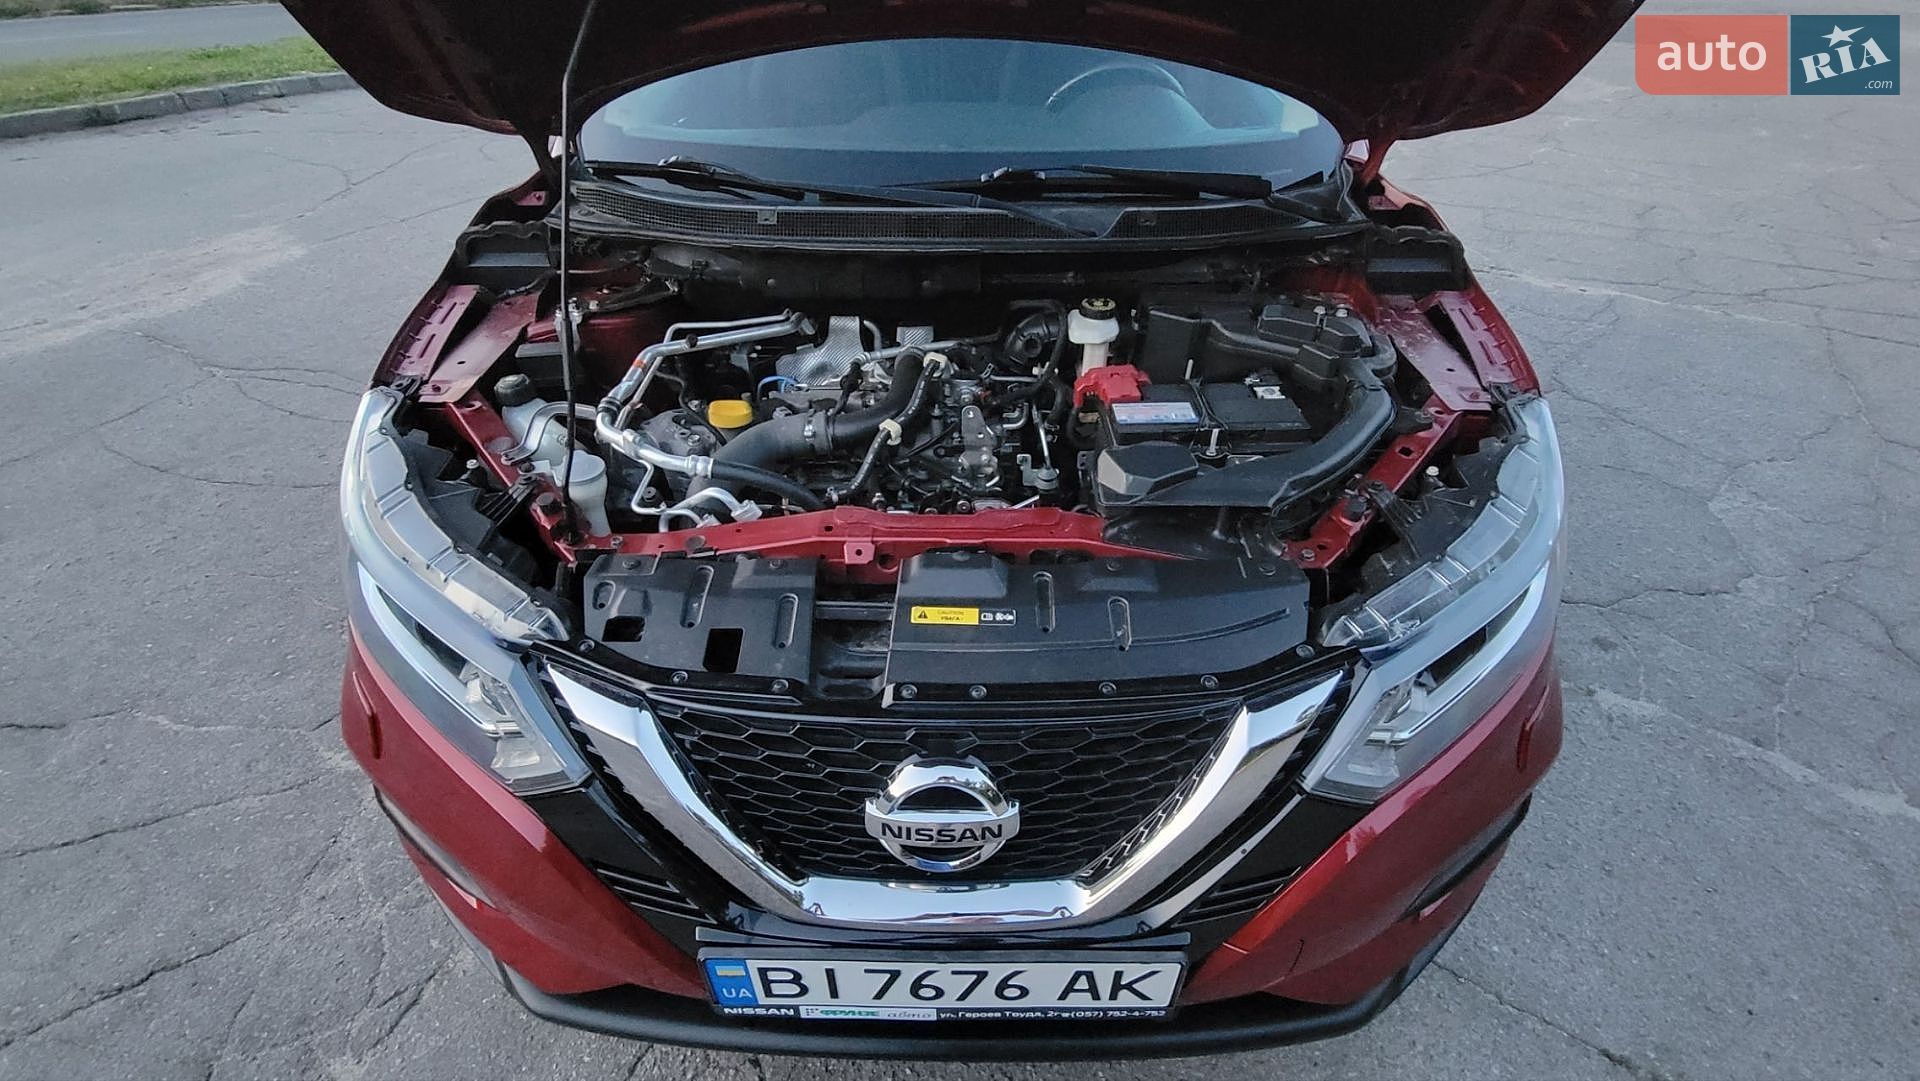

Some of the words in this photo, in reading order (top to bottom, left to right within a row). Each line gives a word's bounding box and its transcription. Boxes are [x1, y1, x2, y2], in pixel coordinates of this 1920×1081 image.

[881, 822, 1003, 843] NISSAN
[722, 986, 753, 999] UA
[757, 967, 839, 999] BI
[864, 968, 1030, 1001] 7676
[1056, 970, 1163, 1001] AK
[723, 1007, 794, 1016] NISSAN
